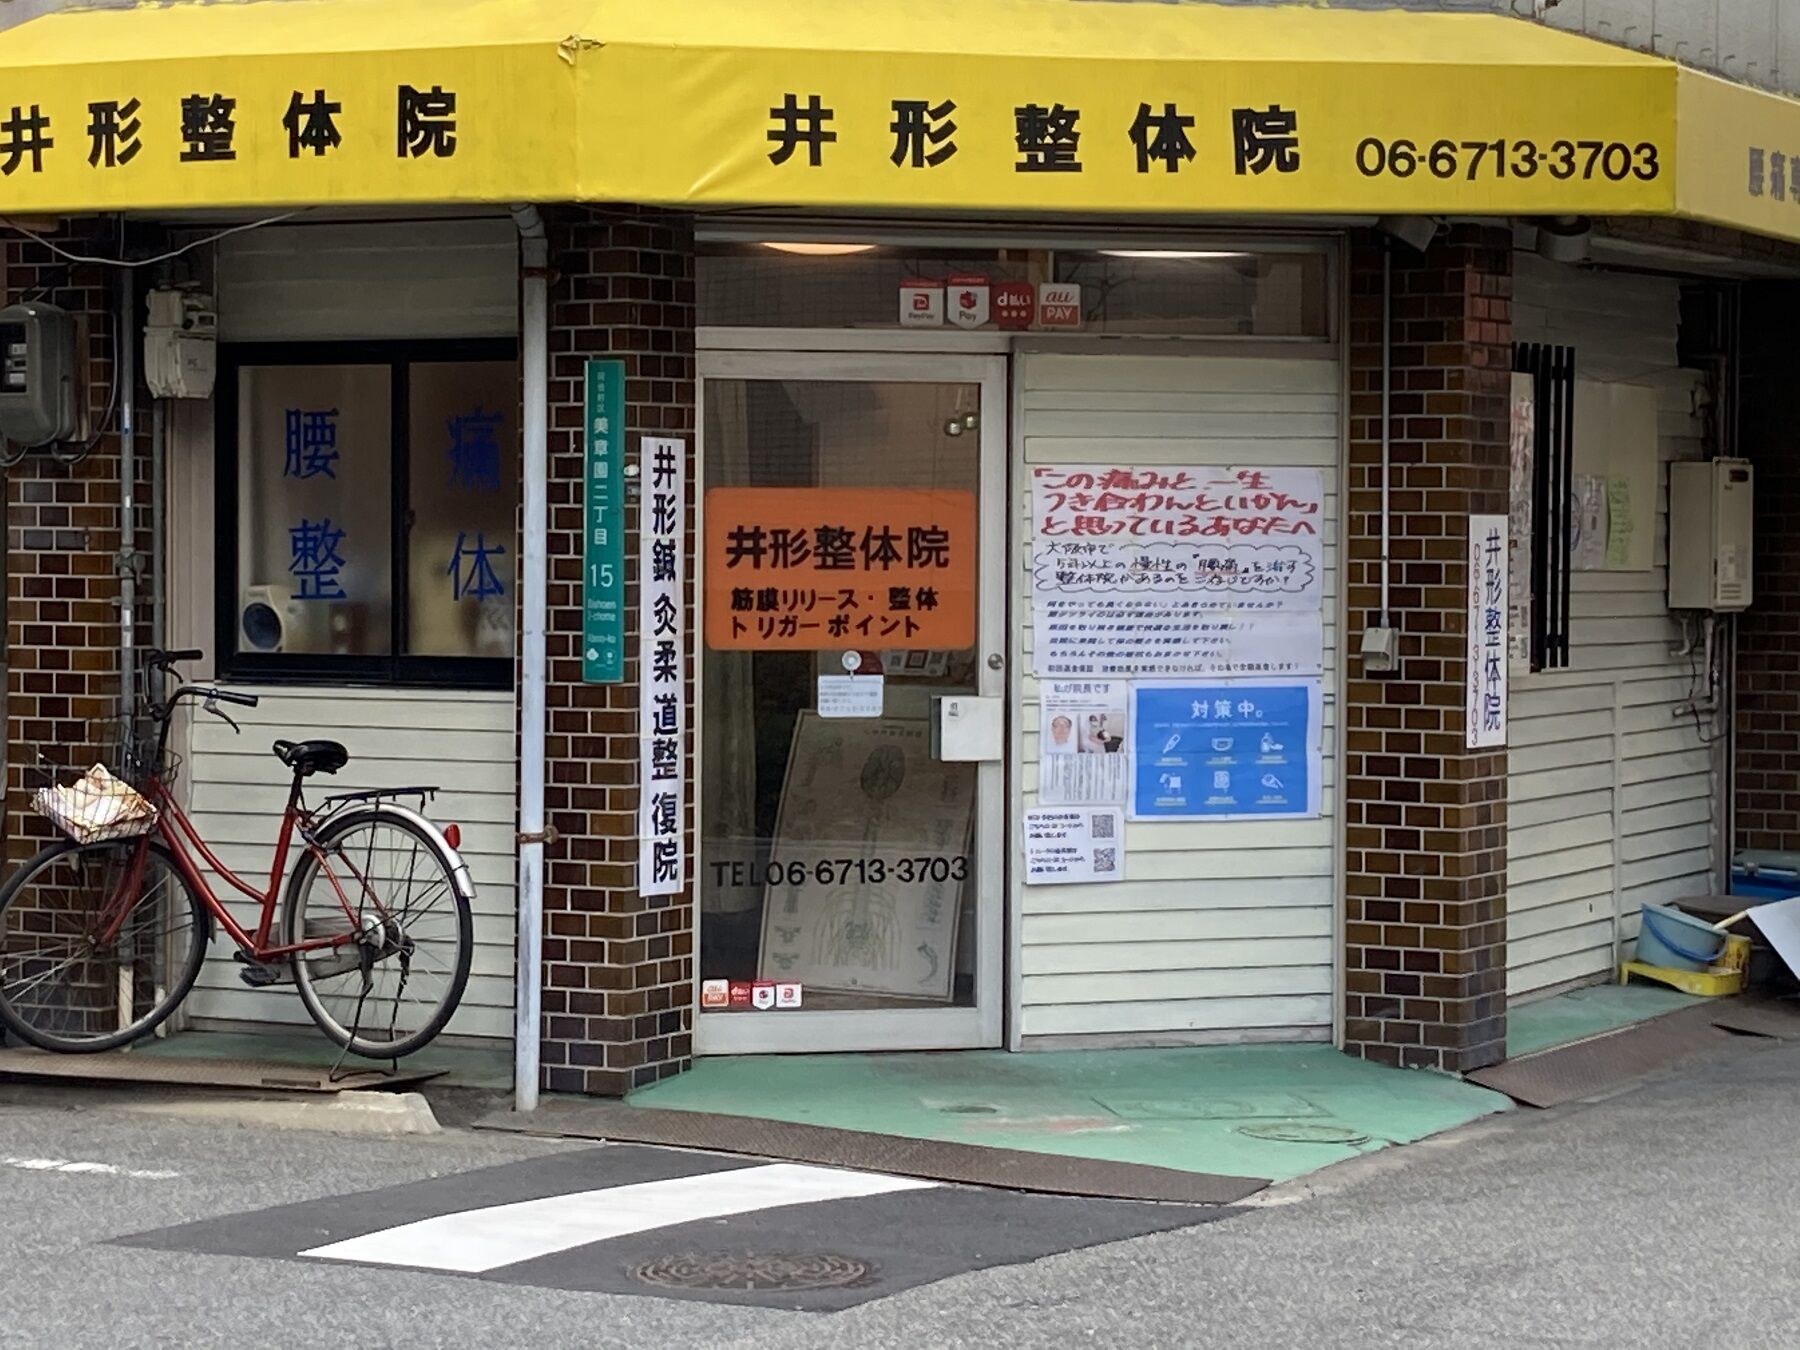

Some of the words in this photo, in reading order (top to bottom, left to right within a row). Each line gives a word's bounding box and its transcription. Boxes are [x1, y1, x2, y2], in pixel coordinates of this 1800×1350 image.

[0, 85, 457, 176] 井形整体院
[767, 93, 1302, 174] 井形整体院
[1355, 136, 1660, 181] 06-6713-3703
[590, 563, 614, 588] 15
[725, 524, 951, 571] 井形整体院
[652, 445, 679, 885] 井形鍼灸柔道整復院
[731, 614, 921, 640] トリガーポイント
[1483, 527, 1503, 733] 井形整体院
